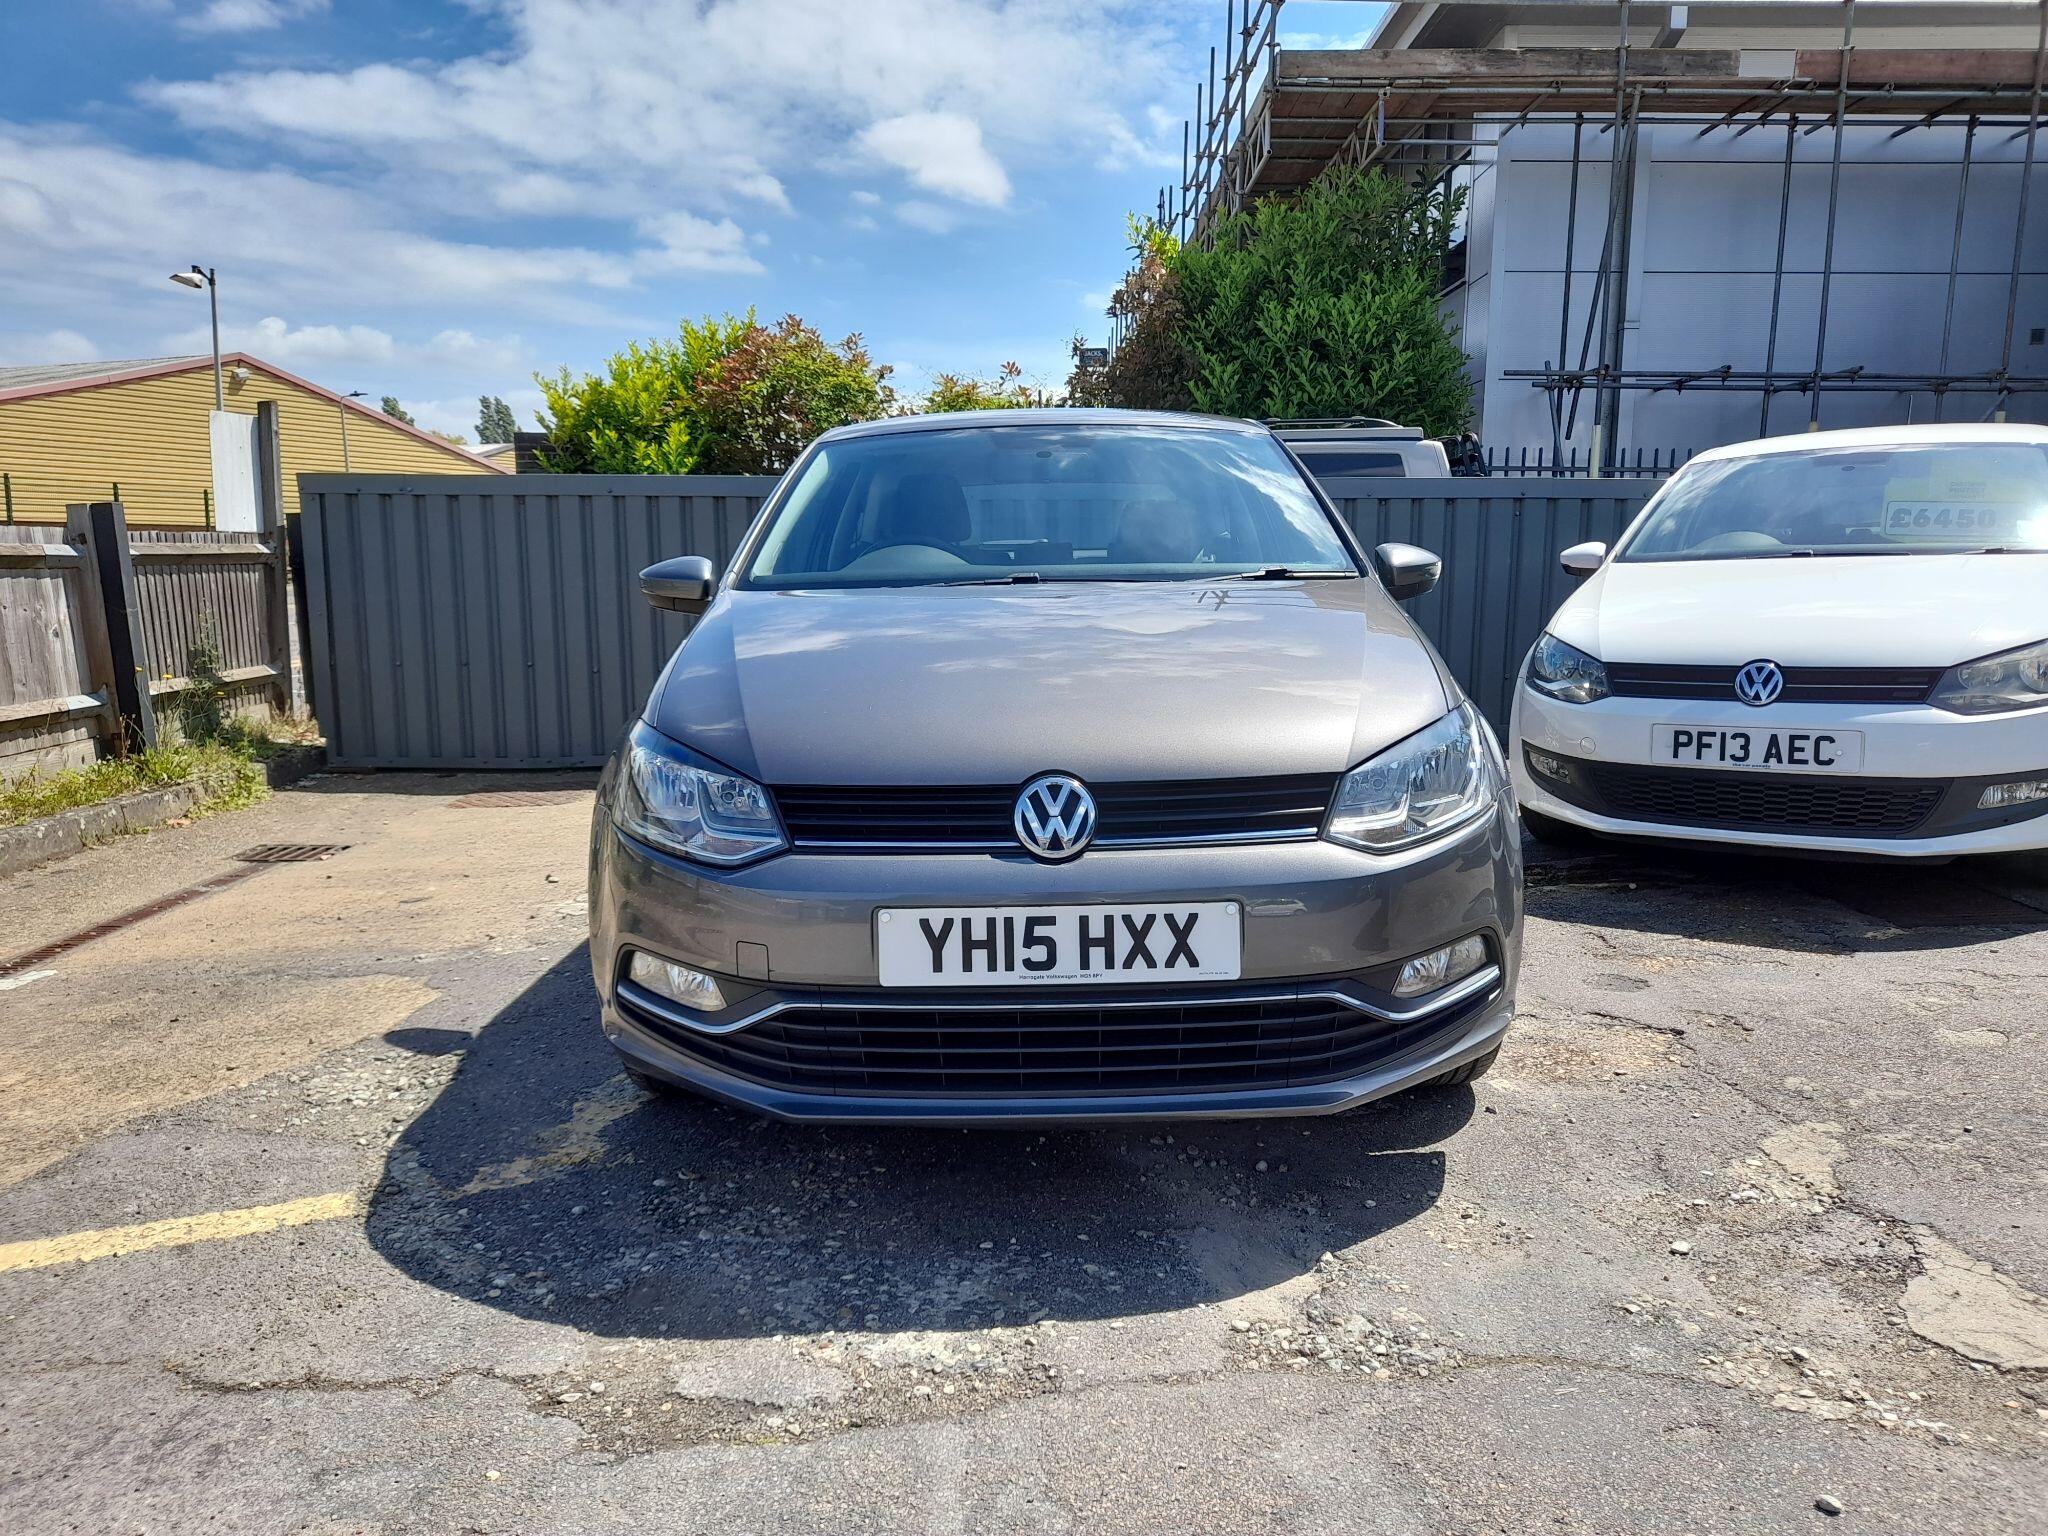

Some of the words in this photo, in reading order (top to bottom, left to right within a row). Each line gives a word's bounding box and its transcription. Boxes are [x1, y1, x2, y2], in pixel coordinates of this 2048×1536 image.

[1888, 507, 1997, 529] £6450
[1672, 729, 1751, 763] PF13
[1762, 733, 1836, 766] AEC
[918, 915, 1058, 973] YH15
[1078, 912, 1200, 971] HXX
